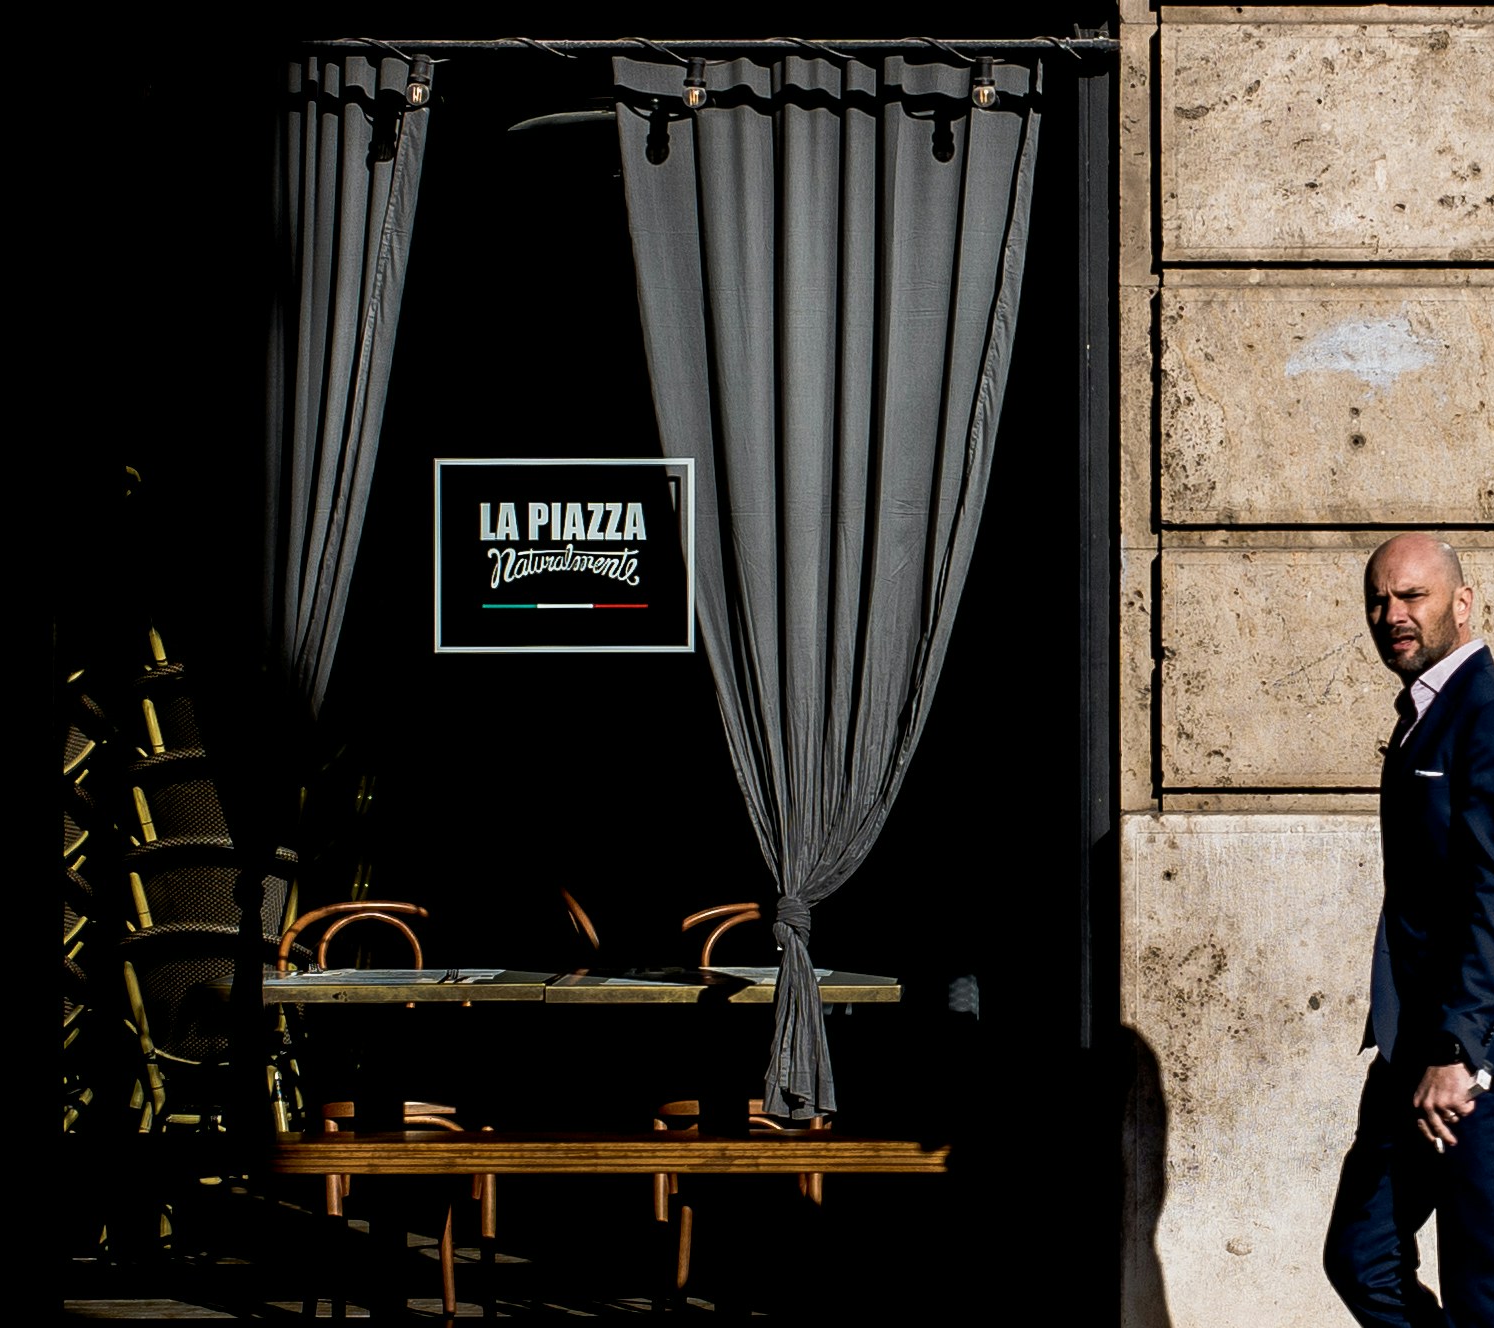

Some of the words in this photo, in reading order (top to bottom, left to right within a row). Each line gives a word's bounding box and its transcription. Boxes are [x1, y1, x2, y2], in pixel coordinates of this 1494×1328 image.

[480, 502, 519, 541] LA
[528, 502, 647, 541] PIAZZA
[488, 544, 640, 589] Naturalmente
